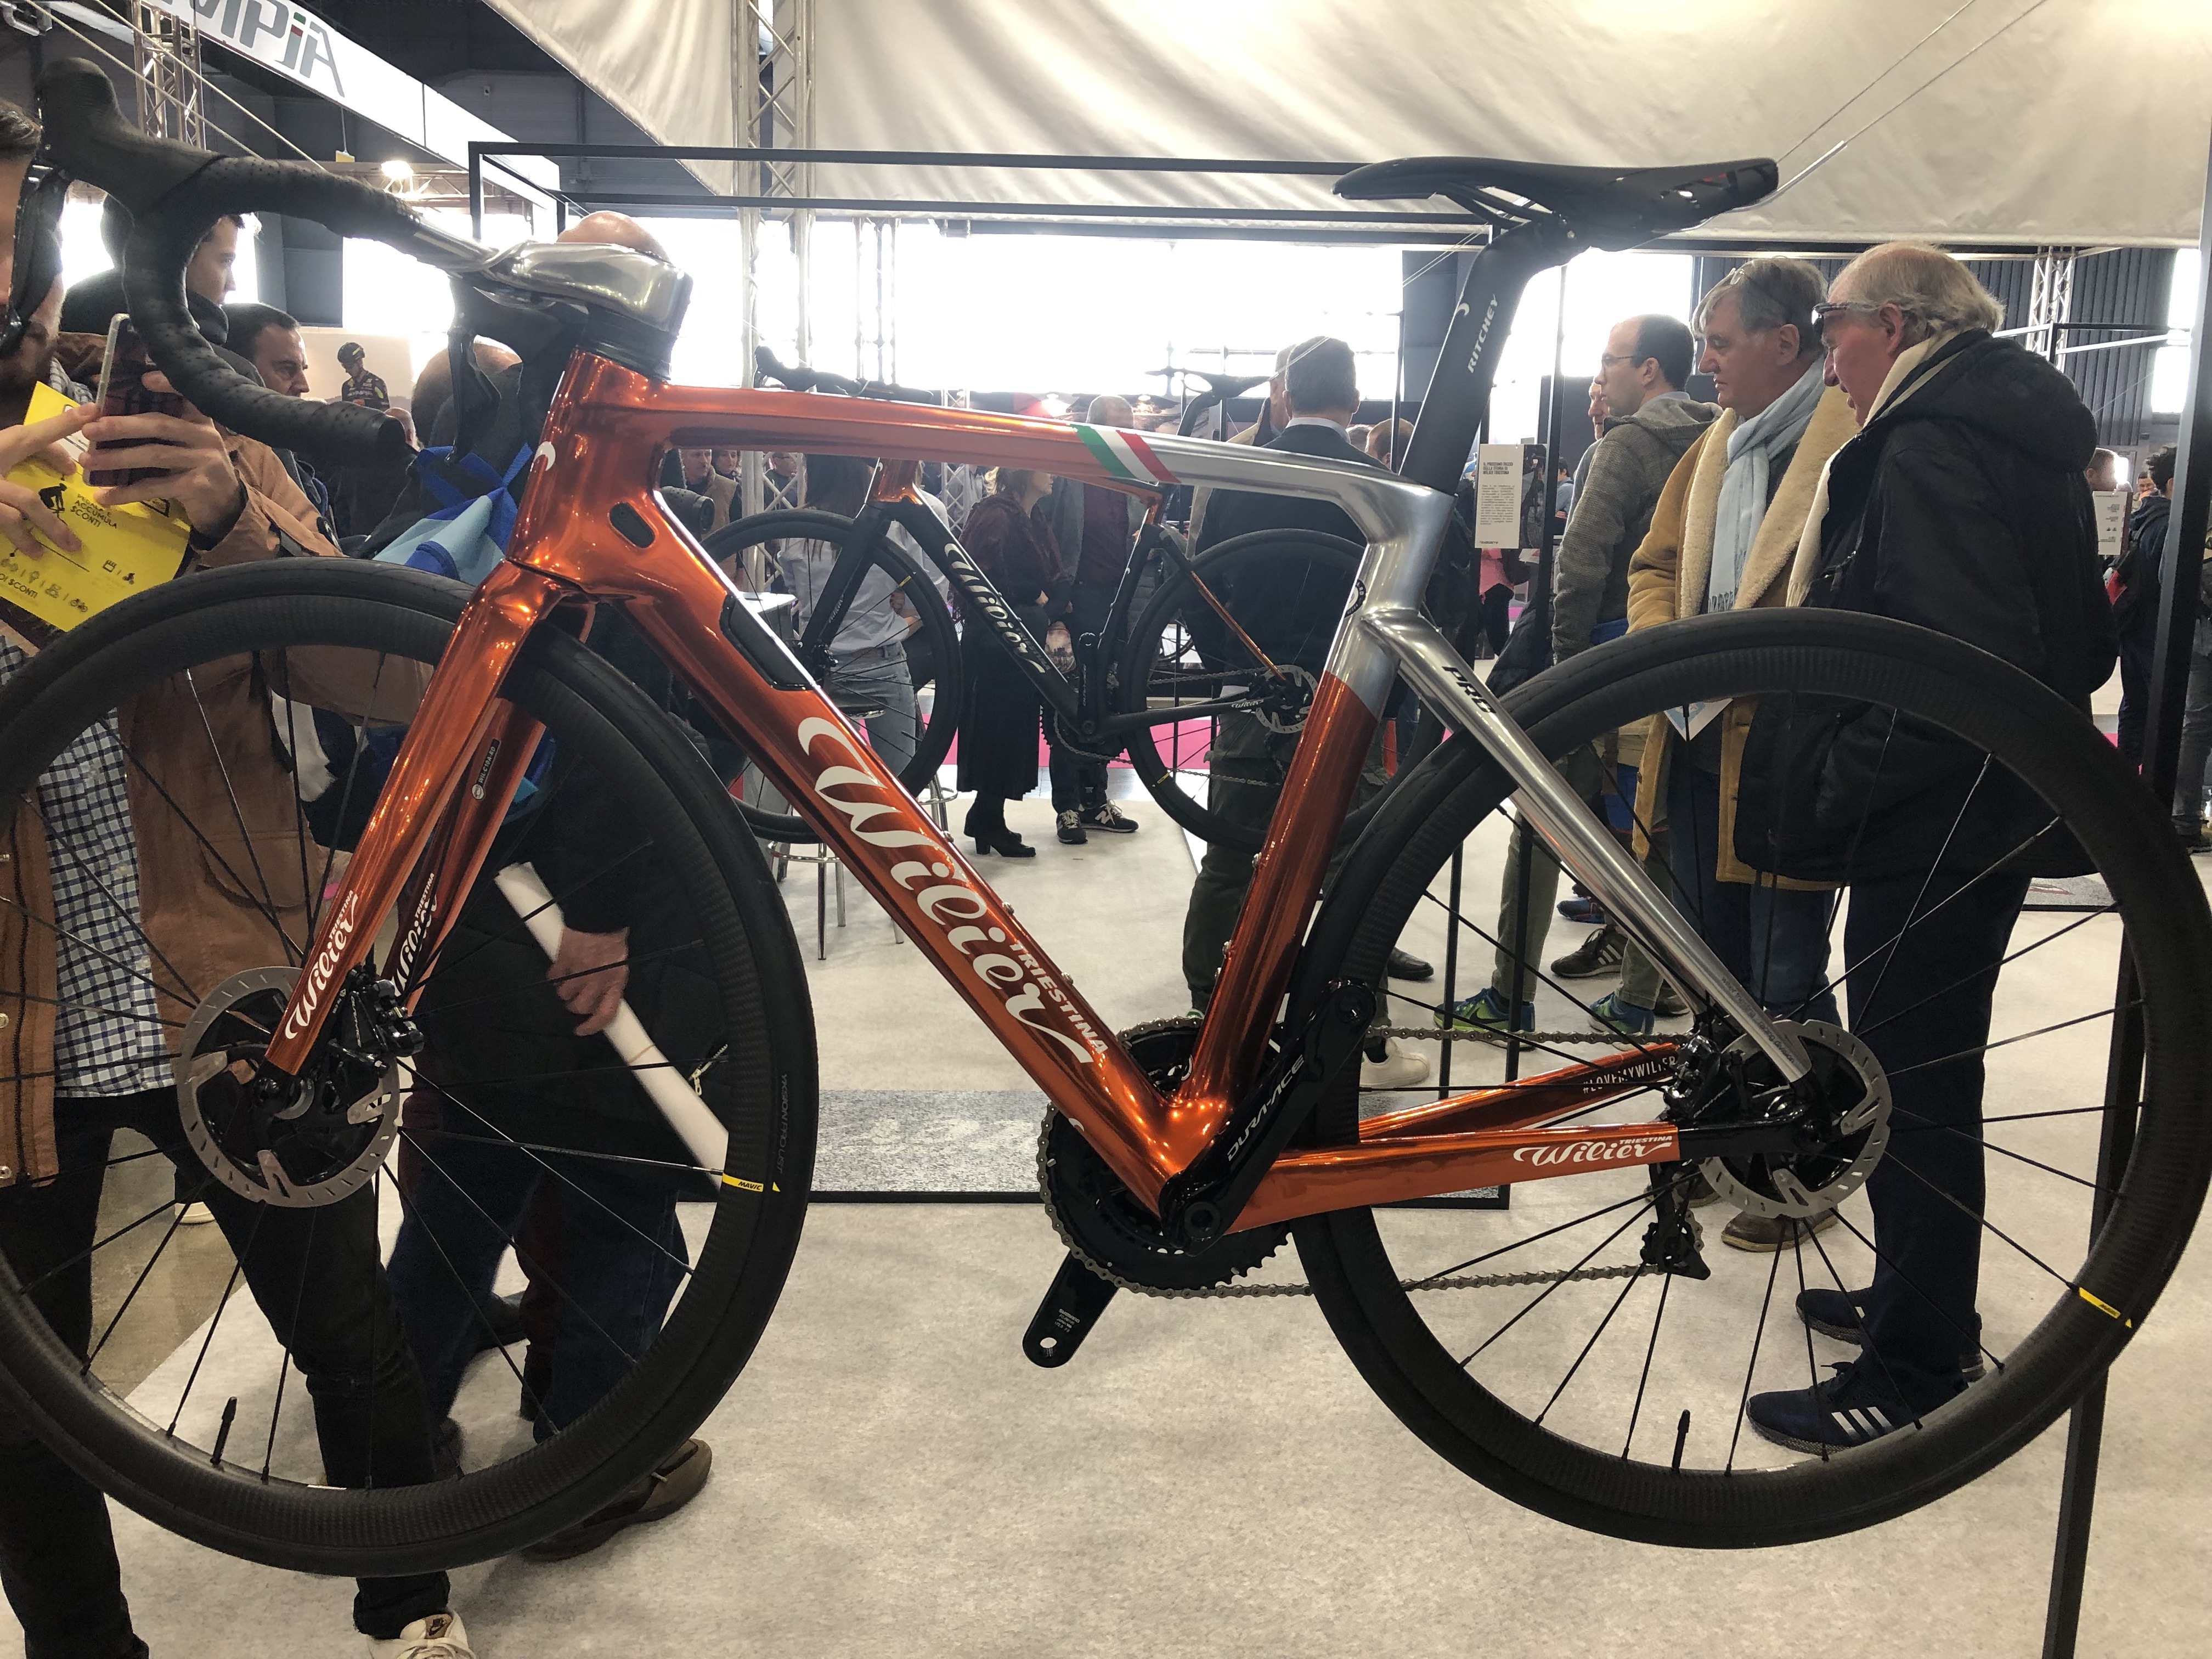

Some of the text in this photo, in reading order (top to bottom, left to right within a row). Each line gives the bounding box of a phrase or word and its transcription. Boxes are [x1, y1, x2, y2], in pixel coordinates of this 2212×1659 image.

[1468, 293, 1498, 374] RITCHEY
[70, 505, 101, 527] SCONTI
[74, 500, 117, 529] ACCUMULA
[1442, 666, 1497, 714] PRO
[329, 889, 354, 939] TRIESTINA
[414, 872, 435, 918] TRIESTINA
[798, 716, 1094, 1064] Wilier
[285, 893, 358, 1040] Wilier
[1009, 940, 1109, 1053] TRIESTINA
[1227, 1054, 1305, 1161] DURA-ACE
[1513, 1141, 1672, 1166] Wilier
[1619, 1135, 1673, 1146] TRIESTINA
[738, 1181, 762, 1190] MAVIC
